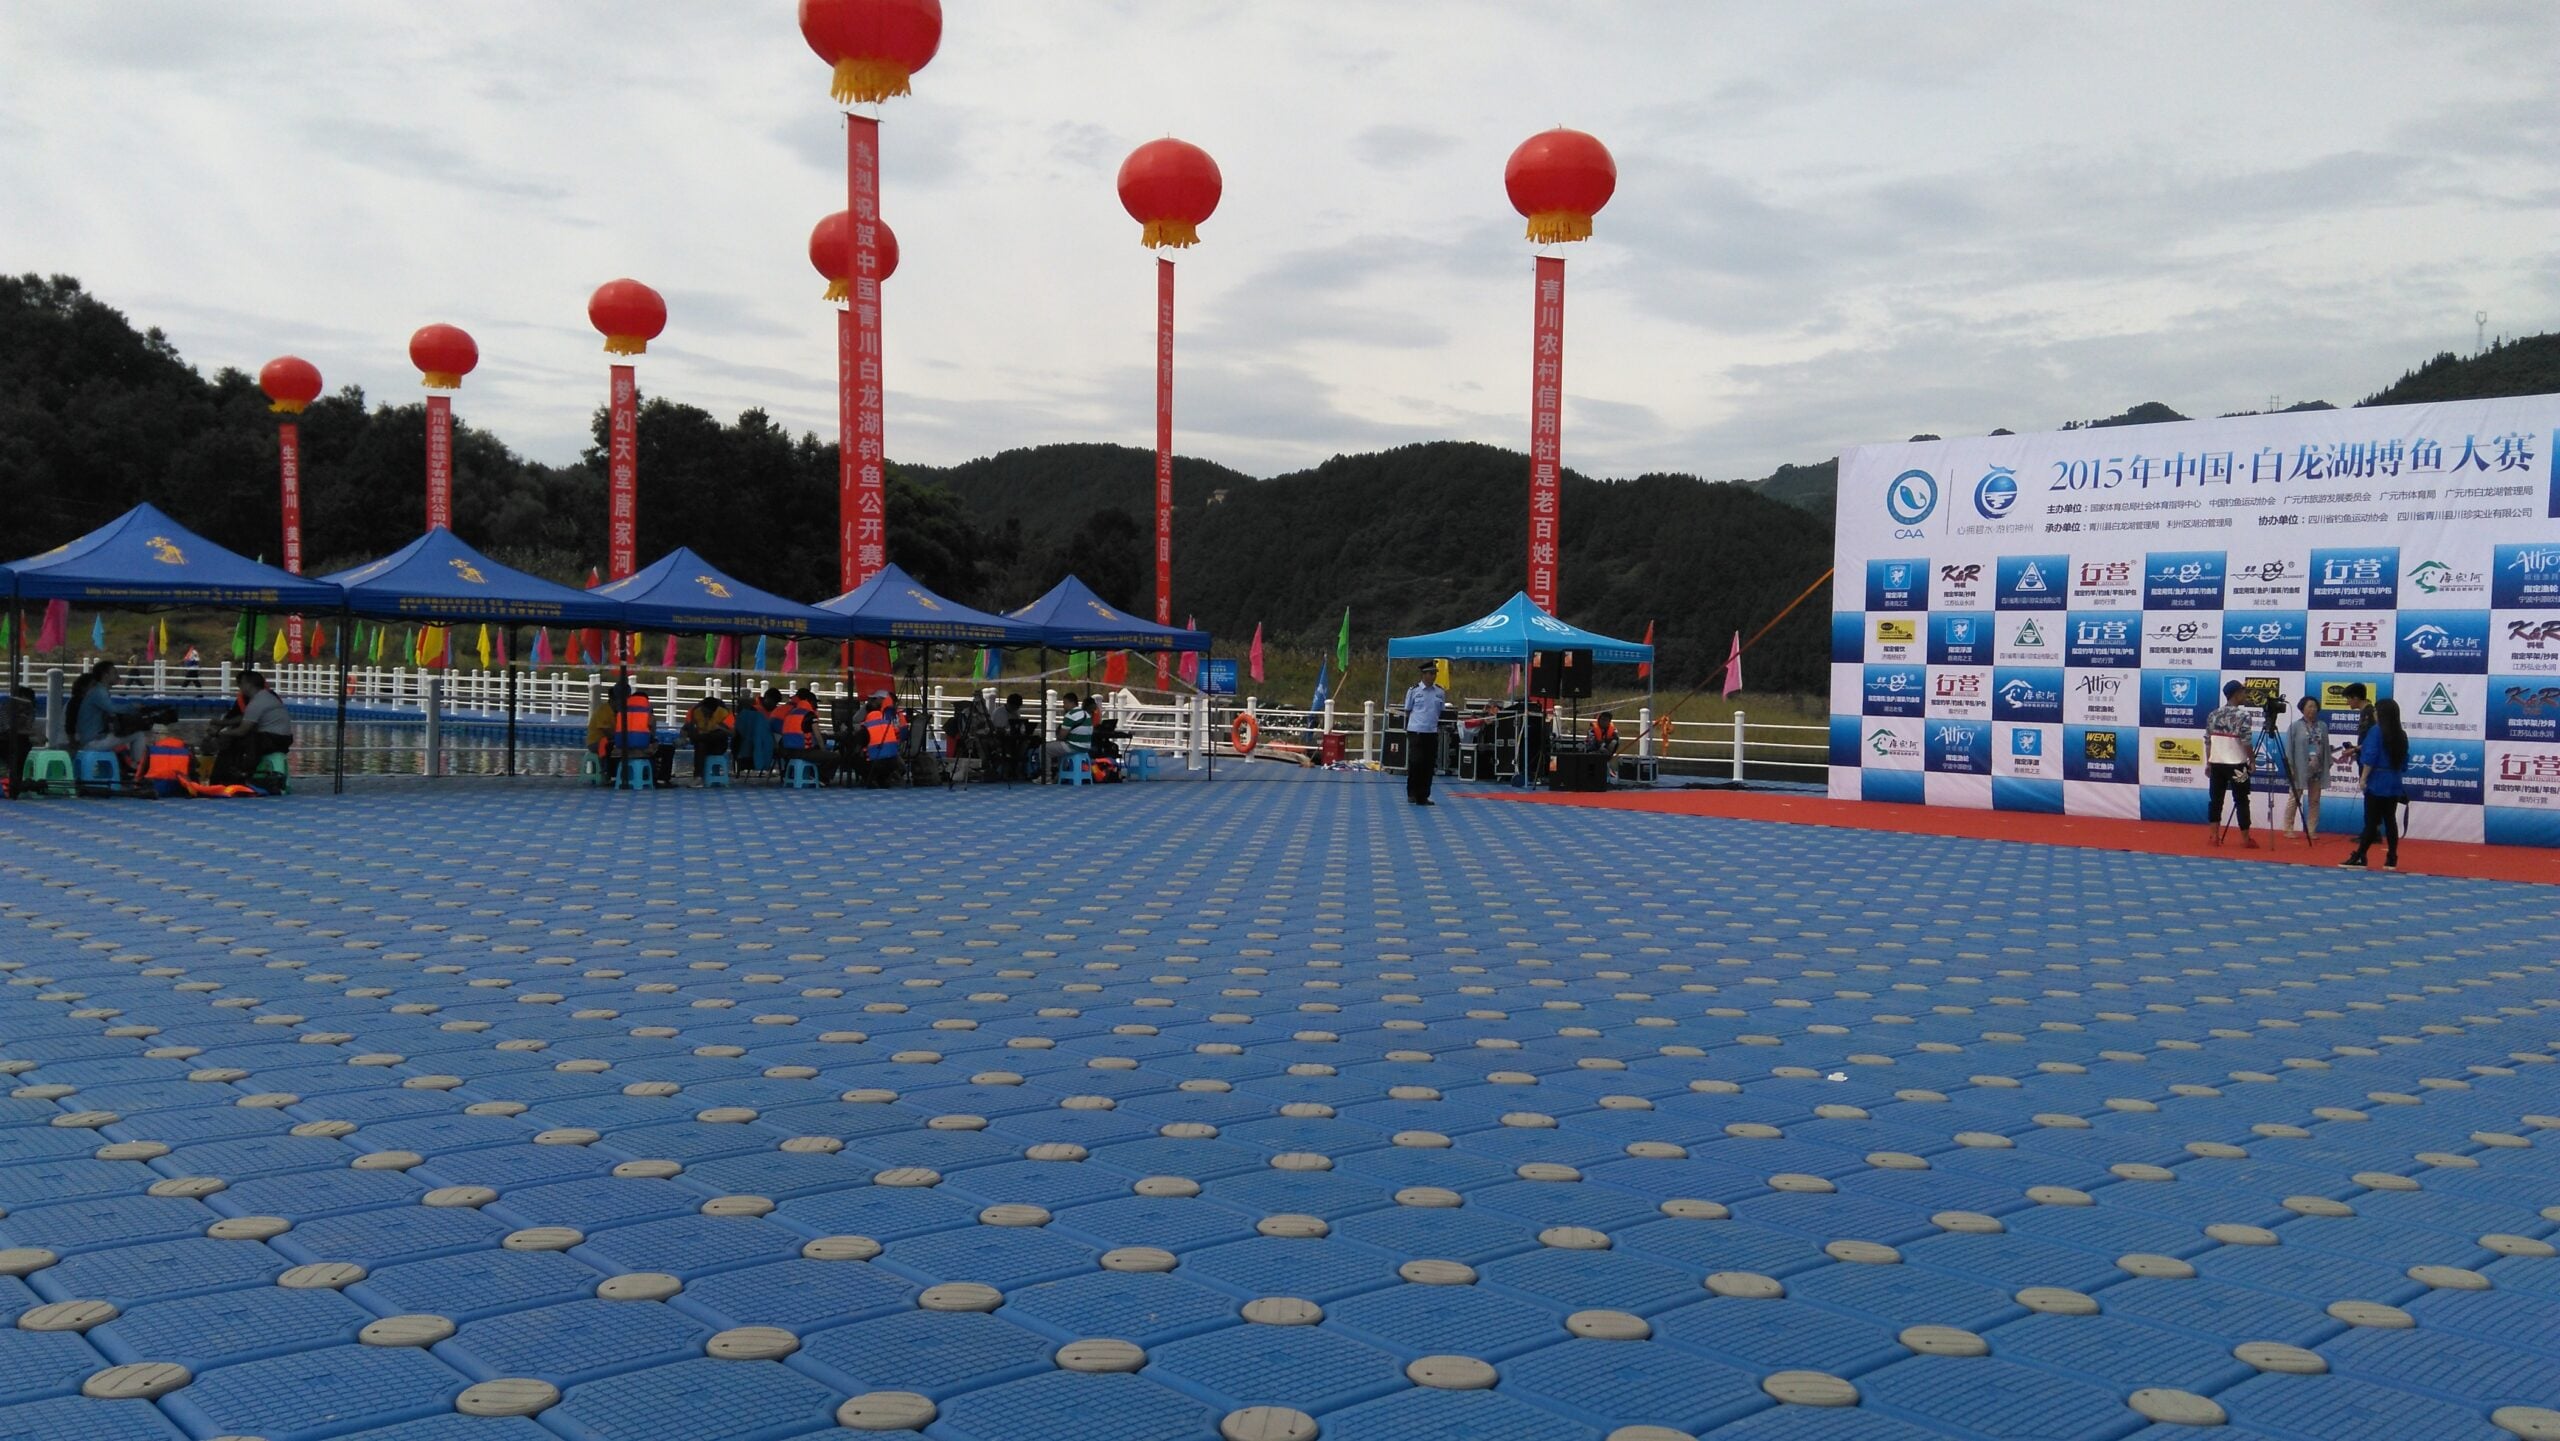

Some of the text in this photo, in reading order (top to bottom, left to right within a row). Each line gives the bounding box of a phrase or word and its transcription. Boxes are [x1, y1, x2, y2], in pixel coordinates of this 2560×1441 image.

[2049, 432, 2536, 491] 2015年中国·白龙湖搏鱼大赛
[614, 379, 632, 574] 梦幻天堂唐家河
[2209, 496, 2276, 508] 中国钓鱼运动协会
[2380, 489, 2436, 501] 广元市体育局
[2445, 485, 2533, 499] 广元市白龙湖管理局
[1894, 529, 1924, 539] CAA
[2080, 562, 2130, 581] 行营
[2324, 558, 2382, 579] 行营
[2508, 548, 2560, 574] Alljo
[1941, 564, 1981, 582] K&R
[2077, 621, 2127, 640] 行营
[2320, 621, 2378, 642] 行营
[1936, 673, 1979, 693] 行营
[2075, 674, 2121, 695] Alljoy
[1935, 725, 1975, 746] Alljoy
[2086, 732, 2115, 742] WENR
[2501, 753, 2560, 776] 行营
